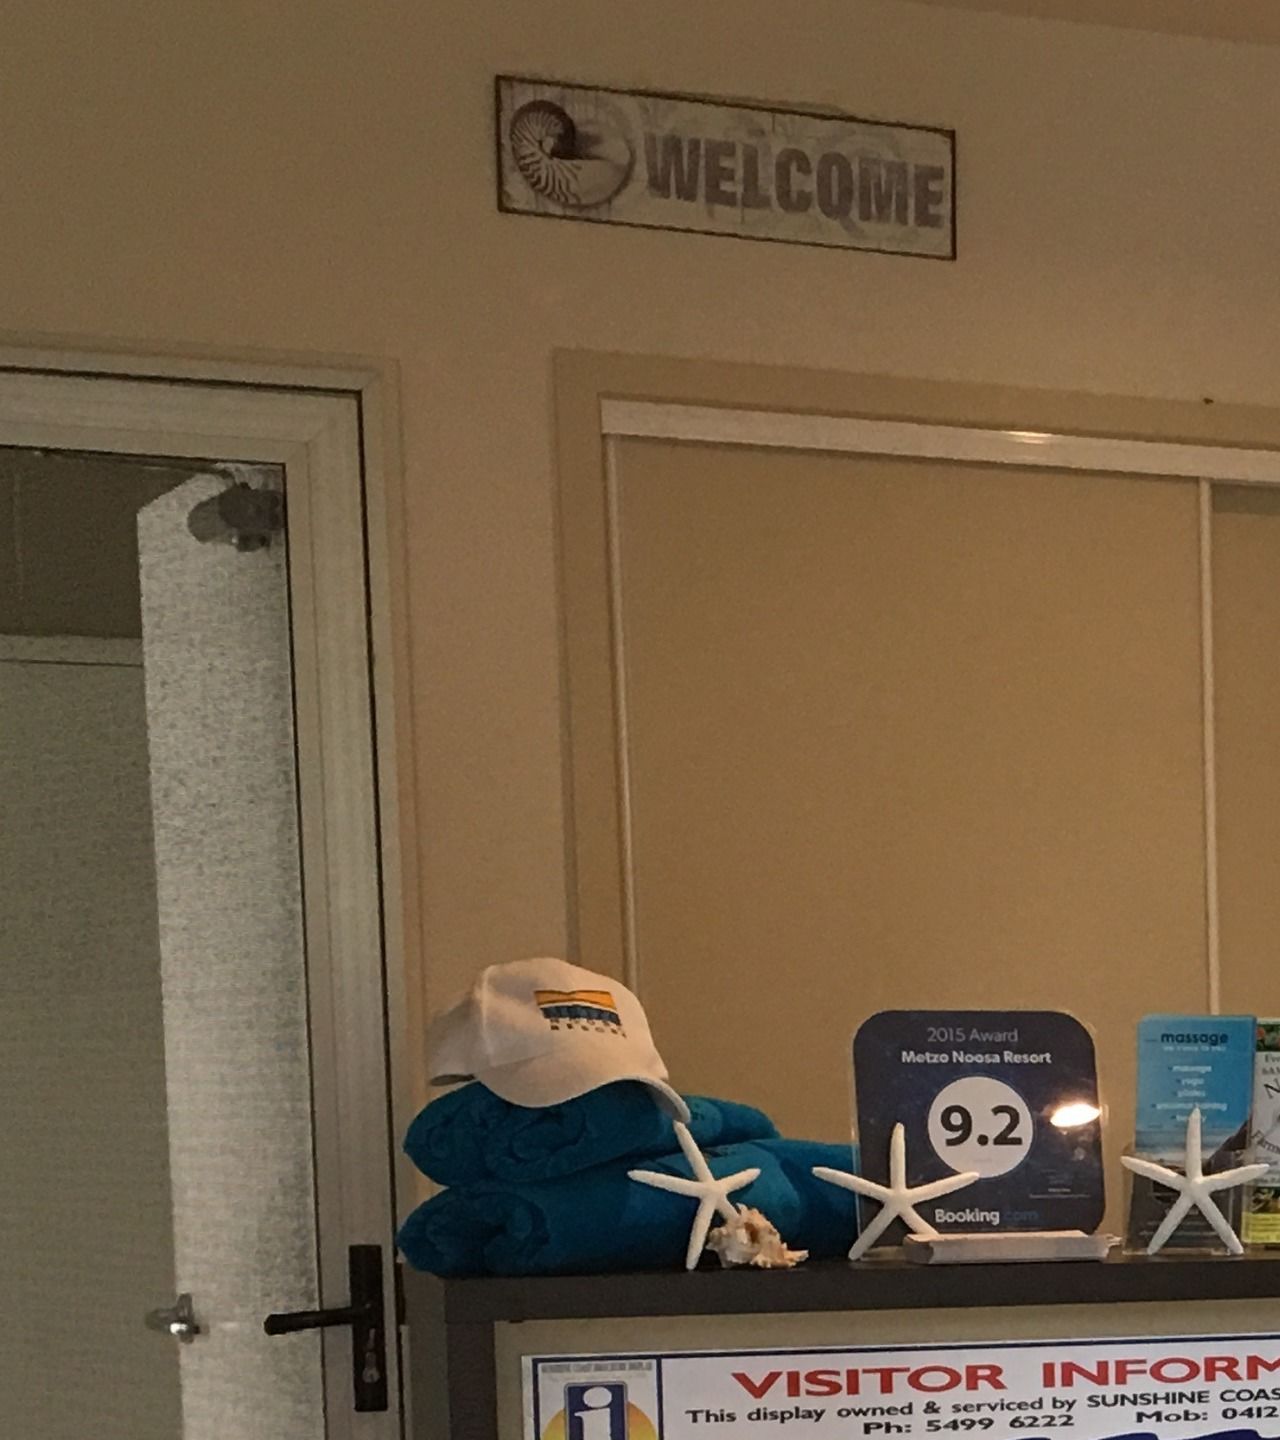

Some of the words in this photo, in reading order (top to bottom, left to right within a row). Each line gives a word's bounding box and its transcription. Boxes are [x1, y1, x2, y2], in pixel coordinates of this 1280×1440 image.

[643, 131, 944, 229] WELCOME
[927, 1027, 966, 1042] 2015
[969, 1028, 1018, 1042] Award
[1161, 1032, 1229, 1046] massage
[902, 1051, 949, 1064] Metzo
[952, 1051, 1000, 1064] Noosa
[1004, 1051, 1052, 1064] Resort
[940, 1104, 1023, 1147] 9.2
[732, 1363, 1007, 1399] VISITOR
[685, 1409, 737, 1424] This
[747, 1405, 826, 1426] display
[837, 1402, 913, 1418] owned
[923, 1400, 941, 1415] &
[951, 1398, 1044, 1414] serviced
[1051, 1397, 1077, 1413] by
[1087, 1389, 1210, 1409] SUNSHINE
[862, 1420, 912, 1436] Ph:
[926, 1417, 994, 1433] 5499
[1009, 1414, 1074, 1430] 6222
[1136, 1408, 1208, 1425] Mob:
[1221, 1405, 1280, 1420] 0412
